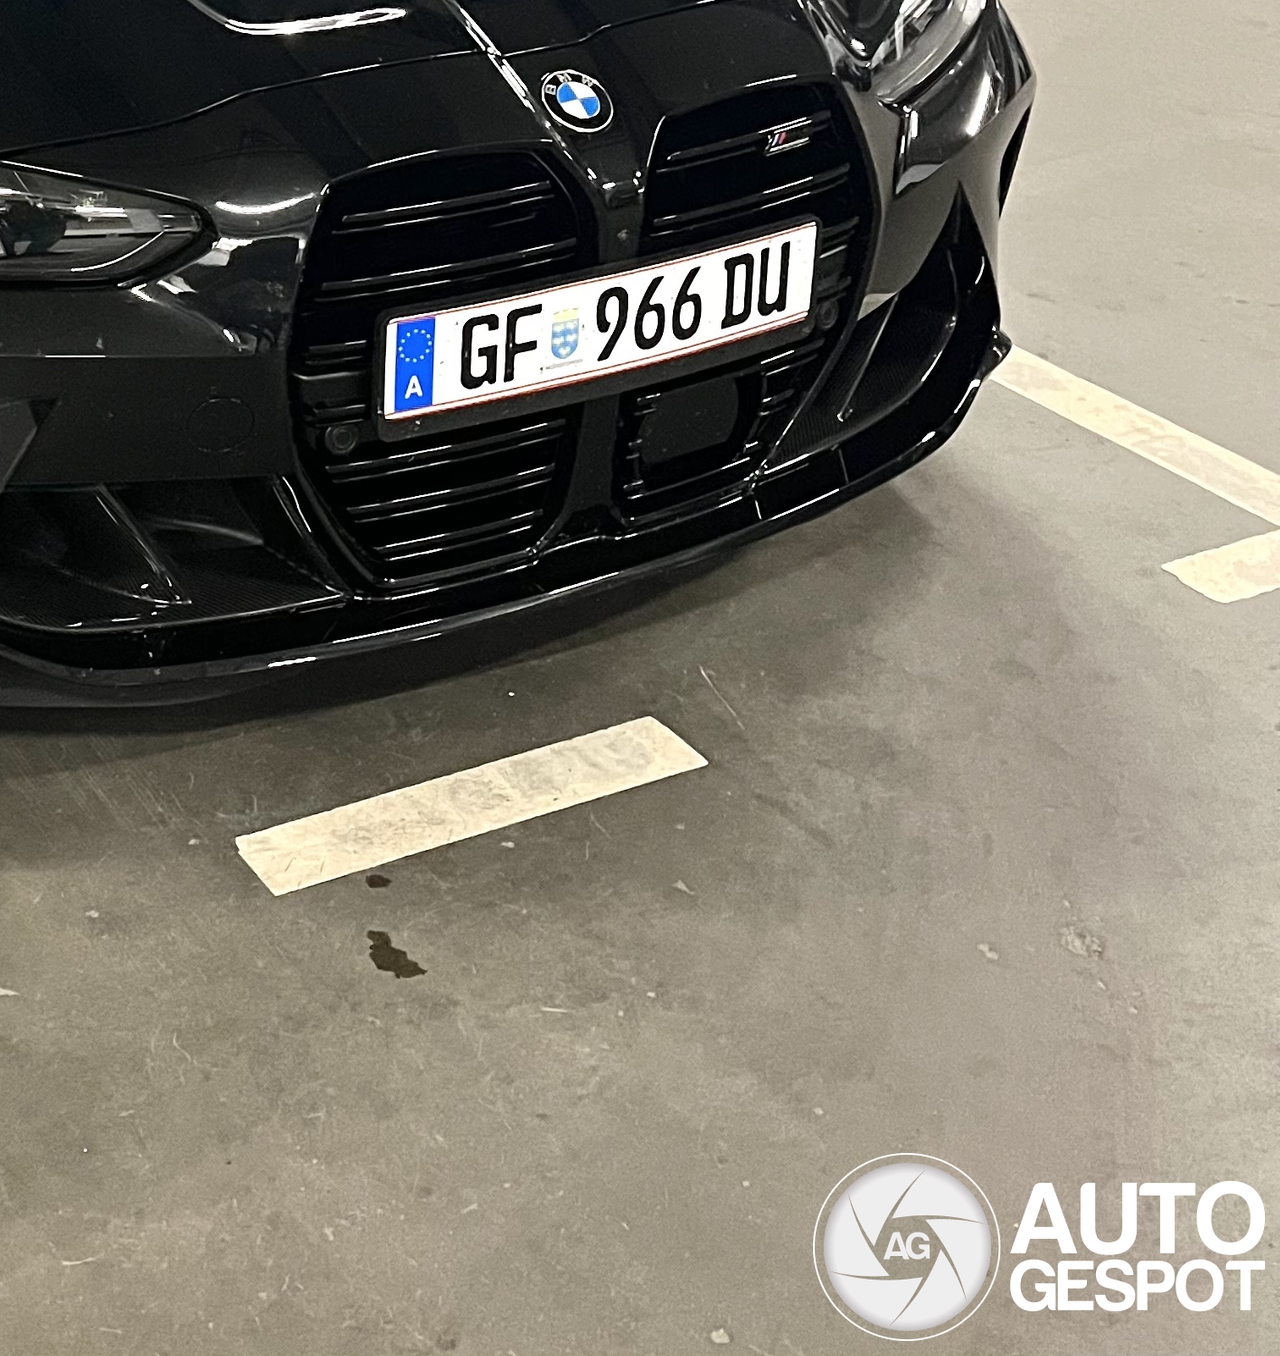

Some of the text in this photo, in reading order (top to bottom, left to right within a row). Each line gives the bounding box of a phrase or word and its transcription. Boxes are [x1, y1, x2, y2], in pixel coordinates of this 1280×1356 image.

[545, 71, 594, 96] BMW
[460, 240, 791, 390] GF 966 DU
[404, 375, 423, 400] A
